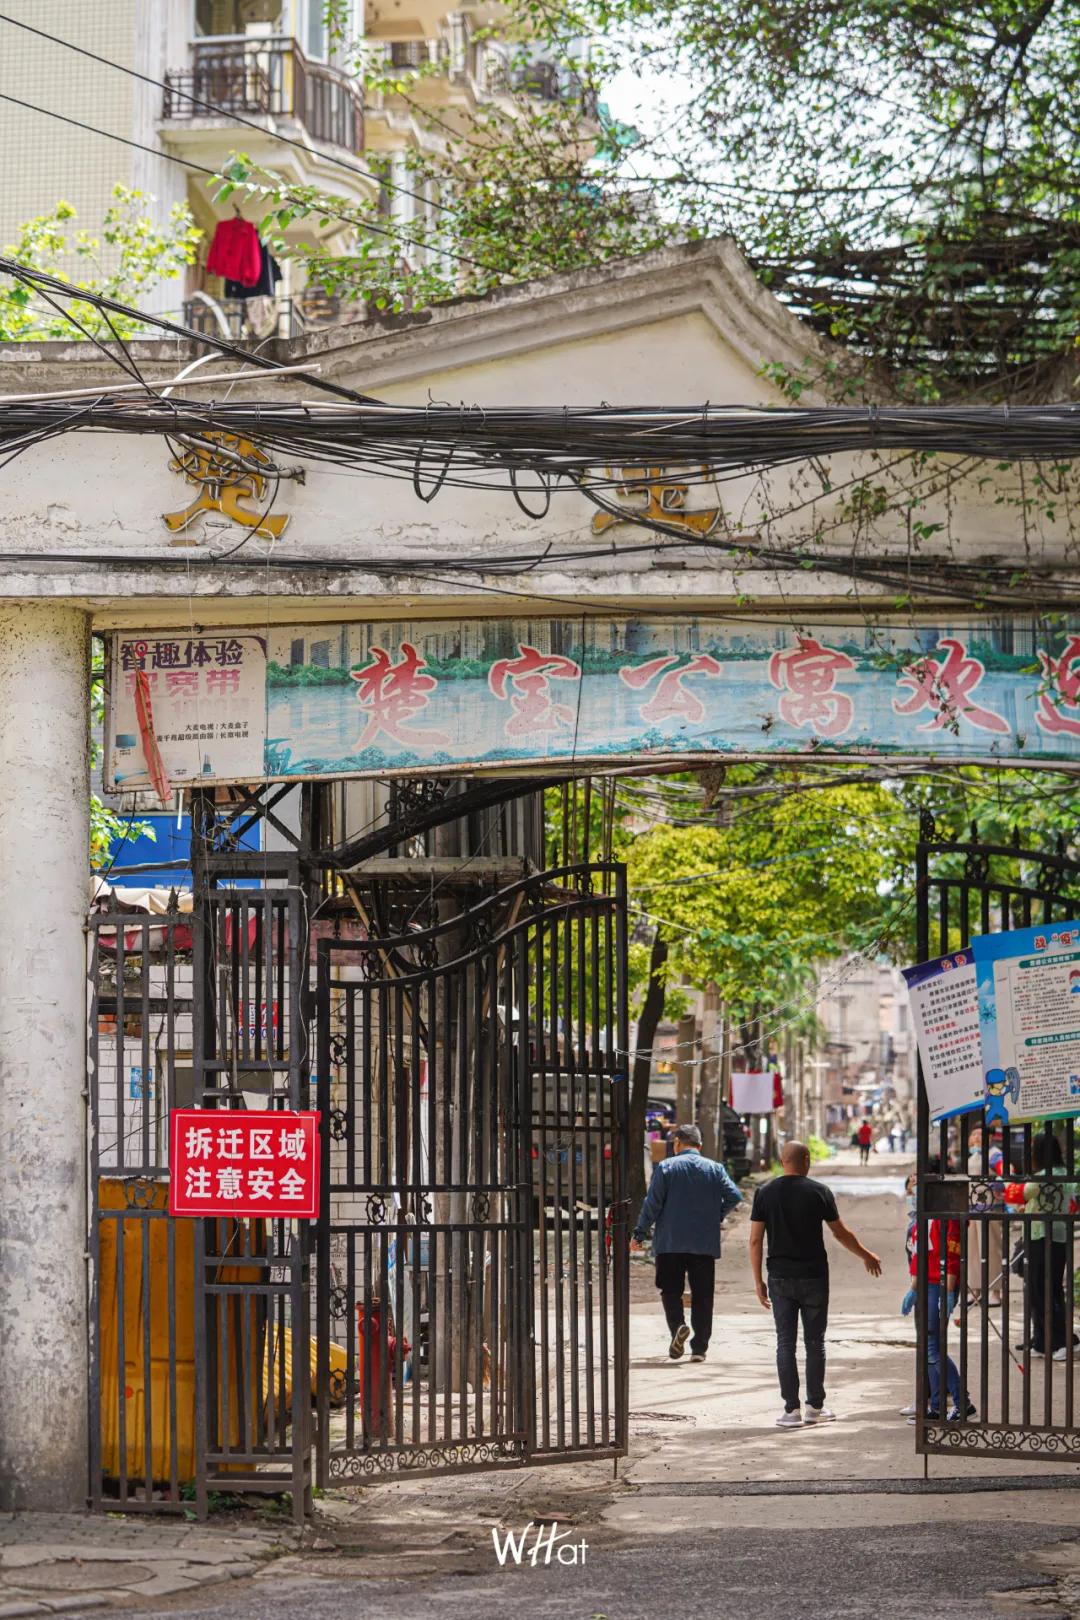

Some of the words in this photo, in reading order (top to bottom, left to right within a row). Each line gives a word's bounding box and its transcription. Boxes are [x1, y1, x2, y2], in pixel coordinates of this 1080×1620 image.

[120, 640, 243, 671] 智趣体验
[184, 1126, 307, 1161] 拆迁区域
[184, 1166, 307, 1200] 注意安全
